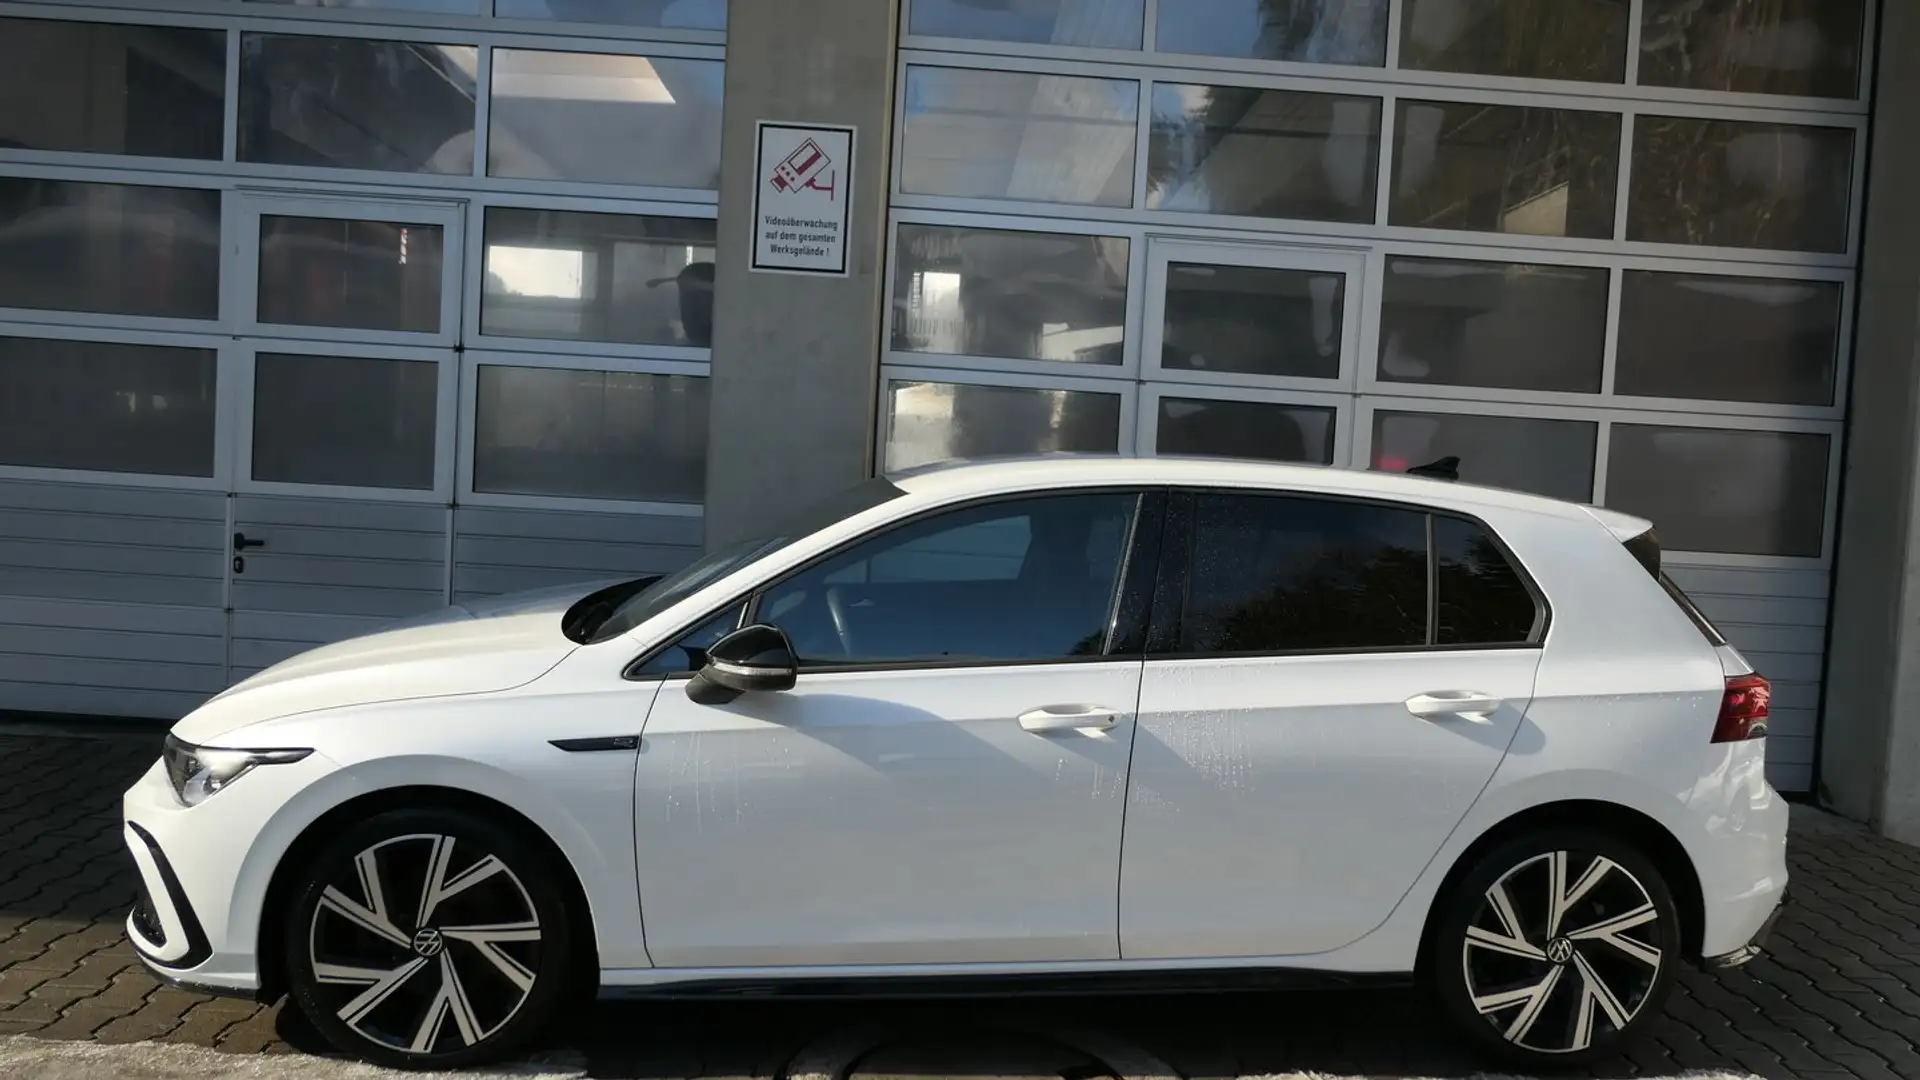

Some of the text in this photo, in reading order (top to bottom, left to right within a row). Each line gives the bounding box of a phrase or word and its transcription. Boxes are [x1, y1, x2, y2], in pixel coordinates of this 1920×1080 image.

[765, 216, 838, 231] Videoüberwachung
[765, 231, 836, 243] auf dem gesamten
[770, 244, 824, 257] Werksgelände
